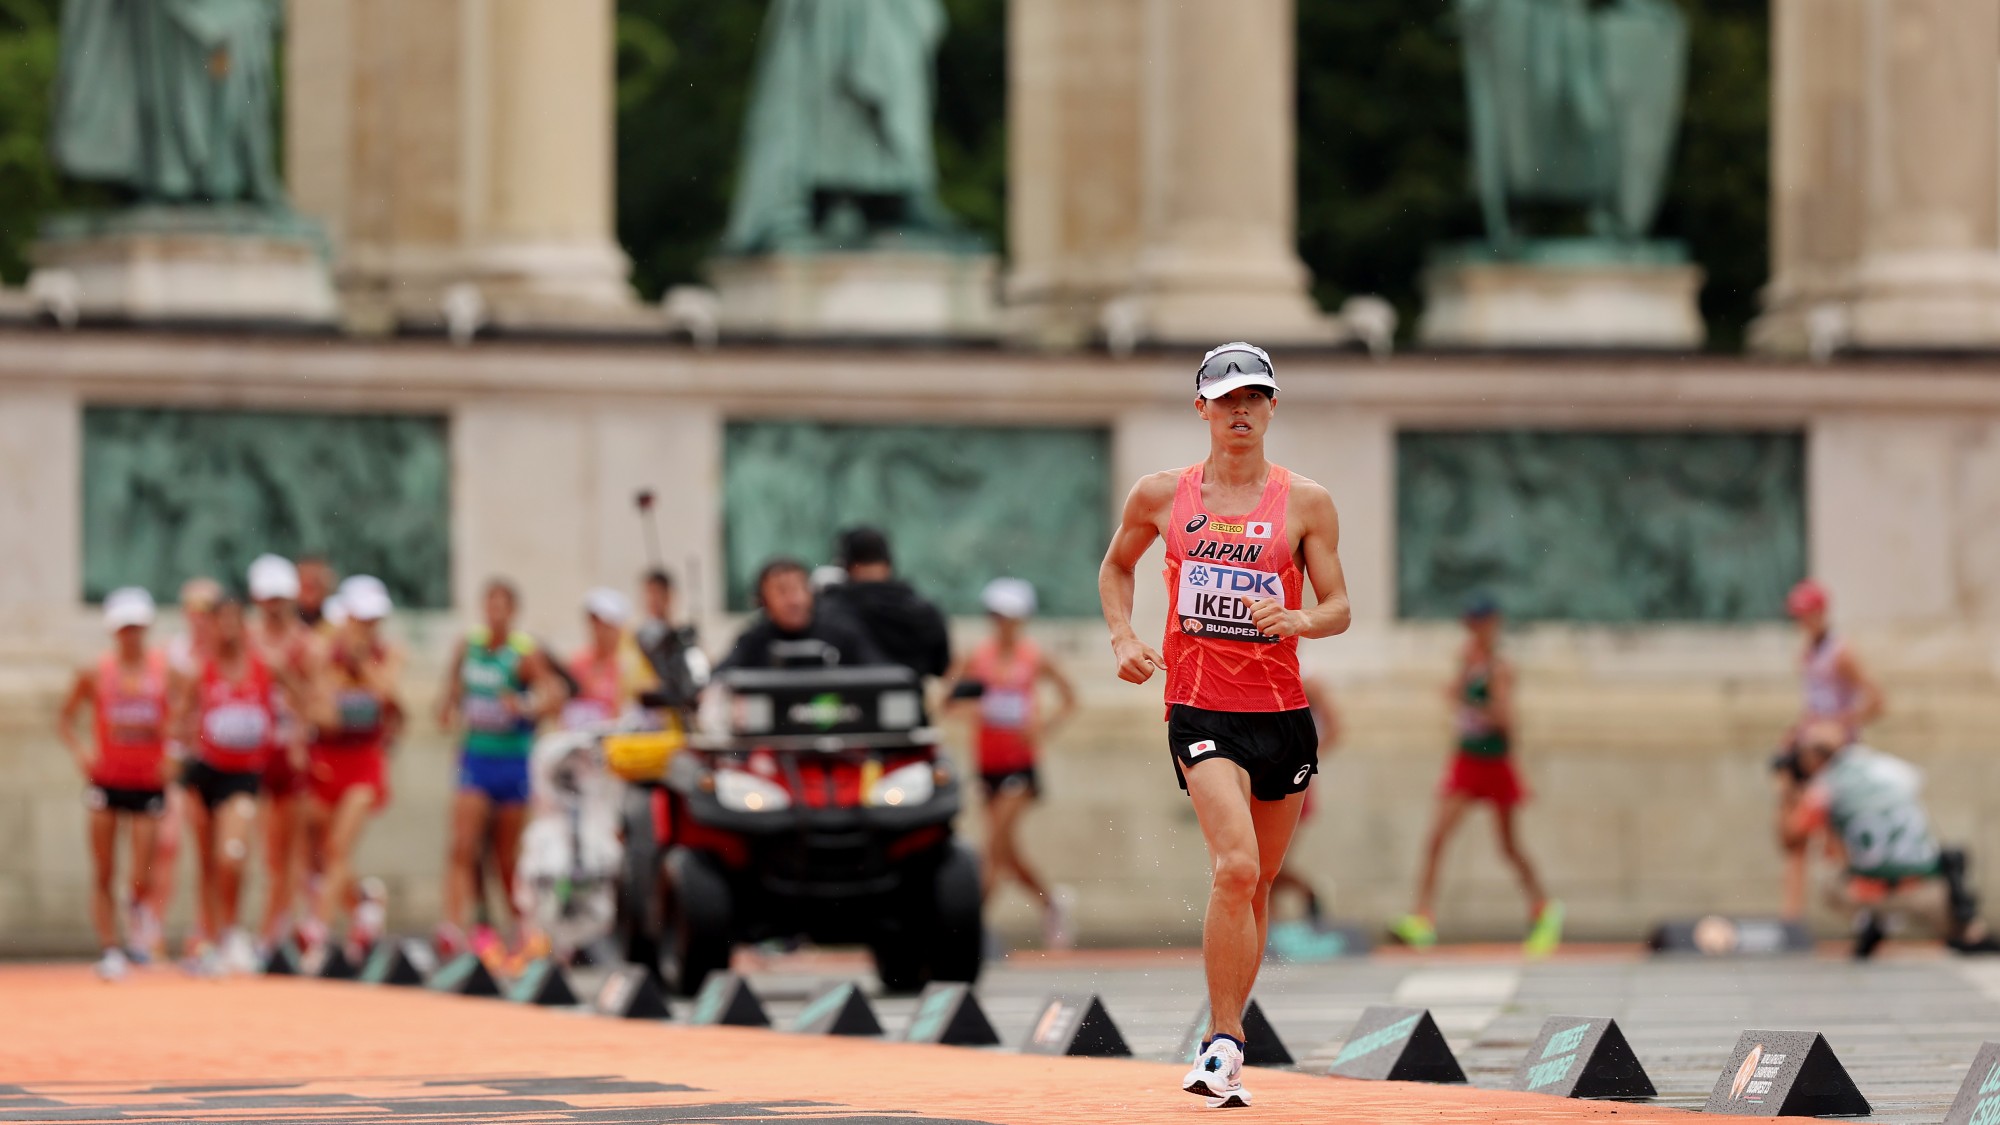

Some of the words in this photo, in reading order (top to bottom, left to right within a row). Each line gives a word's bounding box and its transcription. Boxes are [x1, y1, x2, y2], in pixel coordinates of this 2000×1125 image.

[1210, 522, 1243, 533] SEIKO
[1188, 540, 1263, 563] JAPAN
[1209, 567, 1278, 596] TDK
[1194, 592, 1261, 621] IKED
[1206, 624, 1260, 637] BUDAPEST
